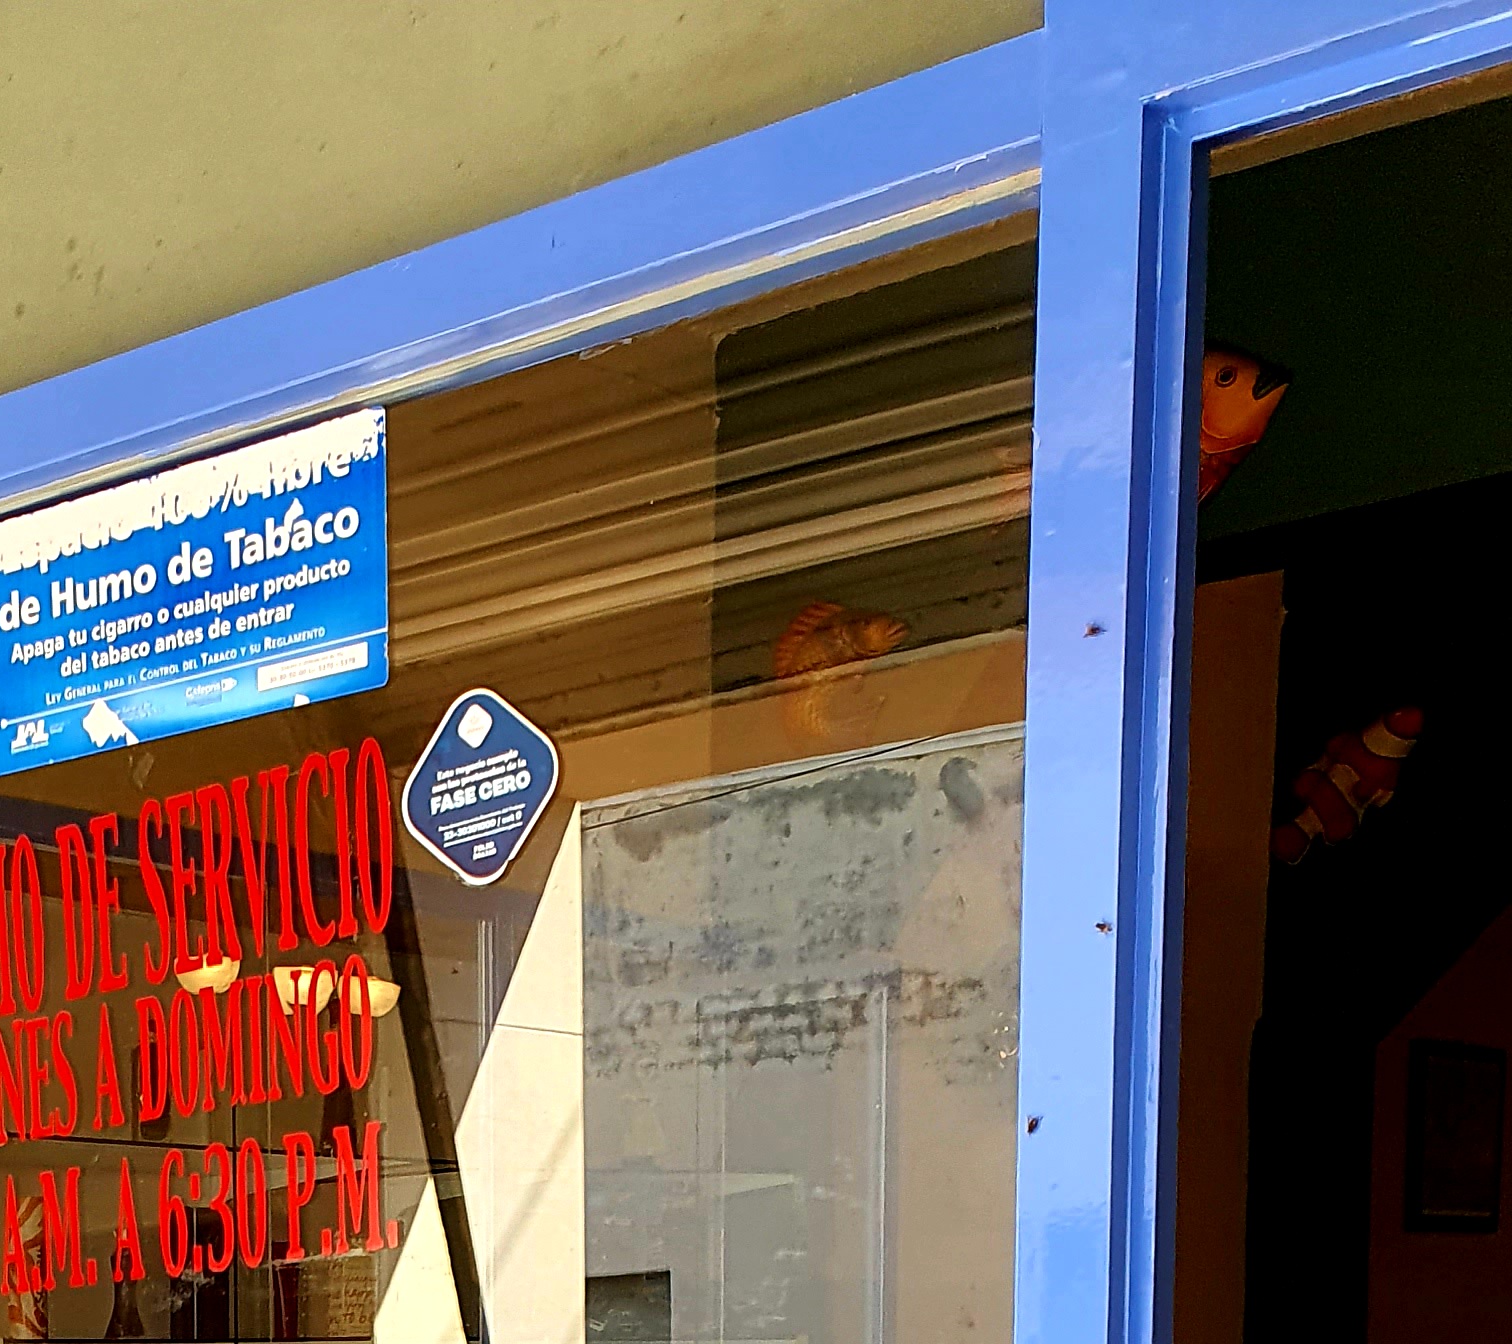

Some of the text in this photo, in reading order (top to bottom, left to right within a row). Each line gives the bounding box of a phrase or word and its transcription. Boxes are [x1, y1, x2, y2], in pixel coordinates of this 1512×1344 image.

[11, 559, 350, 665] Apaga tu cigarro o cualquier producto
[51, 564, 157, 618] Humo
[168, 541, 213, 584] de
[225, 505, 359, 569] Tabaco
[60, 603, 295, 678] del tabaco antes de entrar
[430, 770, 531, 816] FASE CERO
[56, 812, 128, 1001] DE
[138, 737, 393, 986] SERVICIO
[94, 1002, 125, 1130] A
[138, 953, 375, 1121] DOMINGO
[1, 1166, 98, 1295] A.M.
[114, 1156, 146, 1283] A
[159, 1136, 267, 1279] 6:30
[283, 1120, 400, 1263] P.M.
